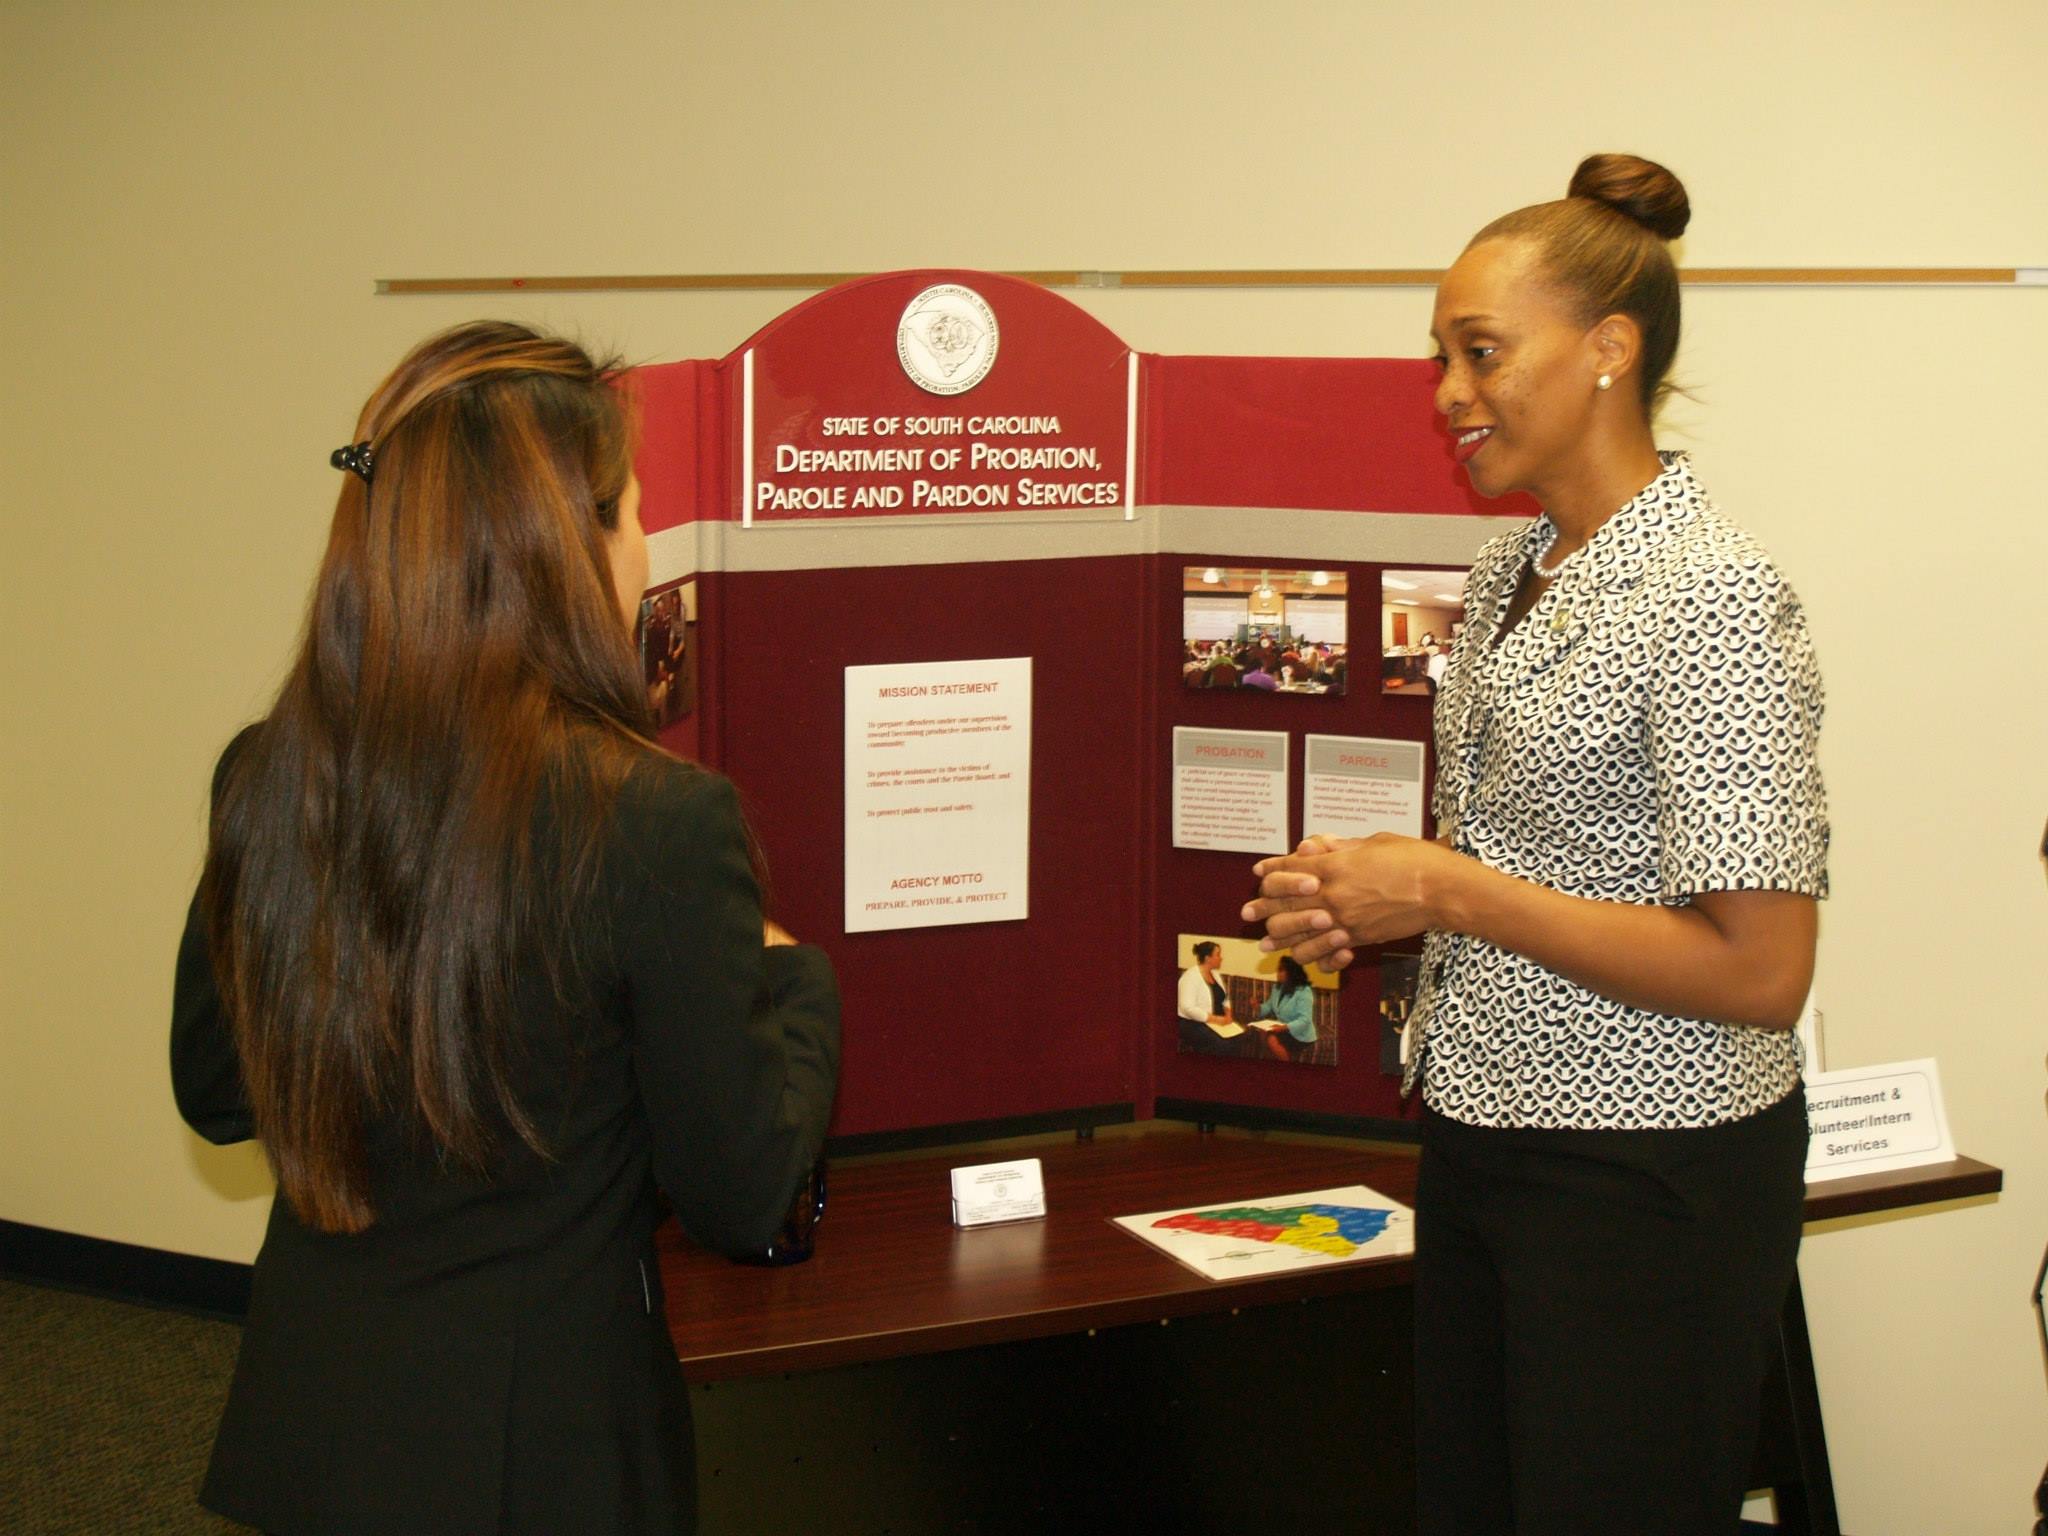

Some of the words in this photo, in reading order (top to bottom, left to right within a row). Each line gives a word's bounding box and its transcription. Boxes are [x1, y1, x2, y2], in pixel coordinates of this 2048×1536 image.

[822, 417, 870, 436] STATE
[873, 417, 901, 435] OF
[904, 416, 963, 435] SOUTH
[967, 415, 1062, 435] CAROLINA
[776, 445, 924, 473] DEPARTMENT
[929, 447, 963, 471] OF
[971, 442, 1102, 471] PROBATION,
[757, 482, 847, 511] PAROLE
[852, 484, 904, 509] AND
[912, 480, 1010, 508] PARDON
[1017, 477, 1120, 506] SERVICES
[879, 686, 928, 699] MISSION
[931, 682, 999, 696] STATEMENT
[1195, 745, 1265, 760] PROBATION
[1339, 754, 1389, 768] PAROLE
[890, 876, 941, 890] AGENCY
[942, 872, 983, 886] MOTTO
[865, 900, 909, 911] PREPARE,
[911, 896, 954, 907] PROVIDE,
[966, 892, 1008, 902] PROTECT
[1806, 1092, 1887, 1113] ecruitment
[1891, 1087, 1901, 1100] &
[1807, 1111, 1912, 1136] olunteer/Intern
[1826, 1139, 1889, 1157] Services
